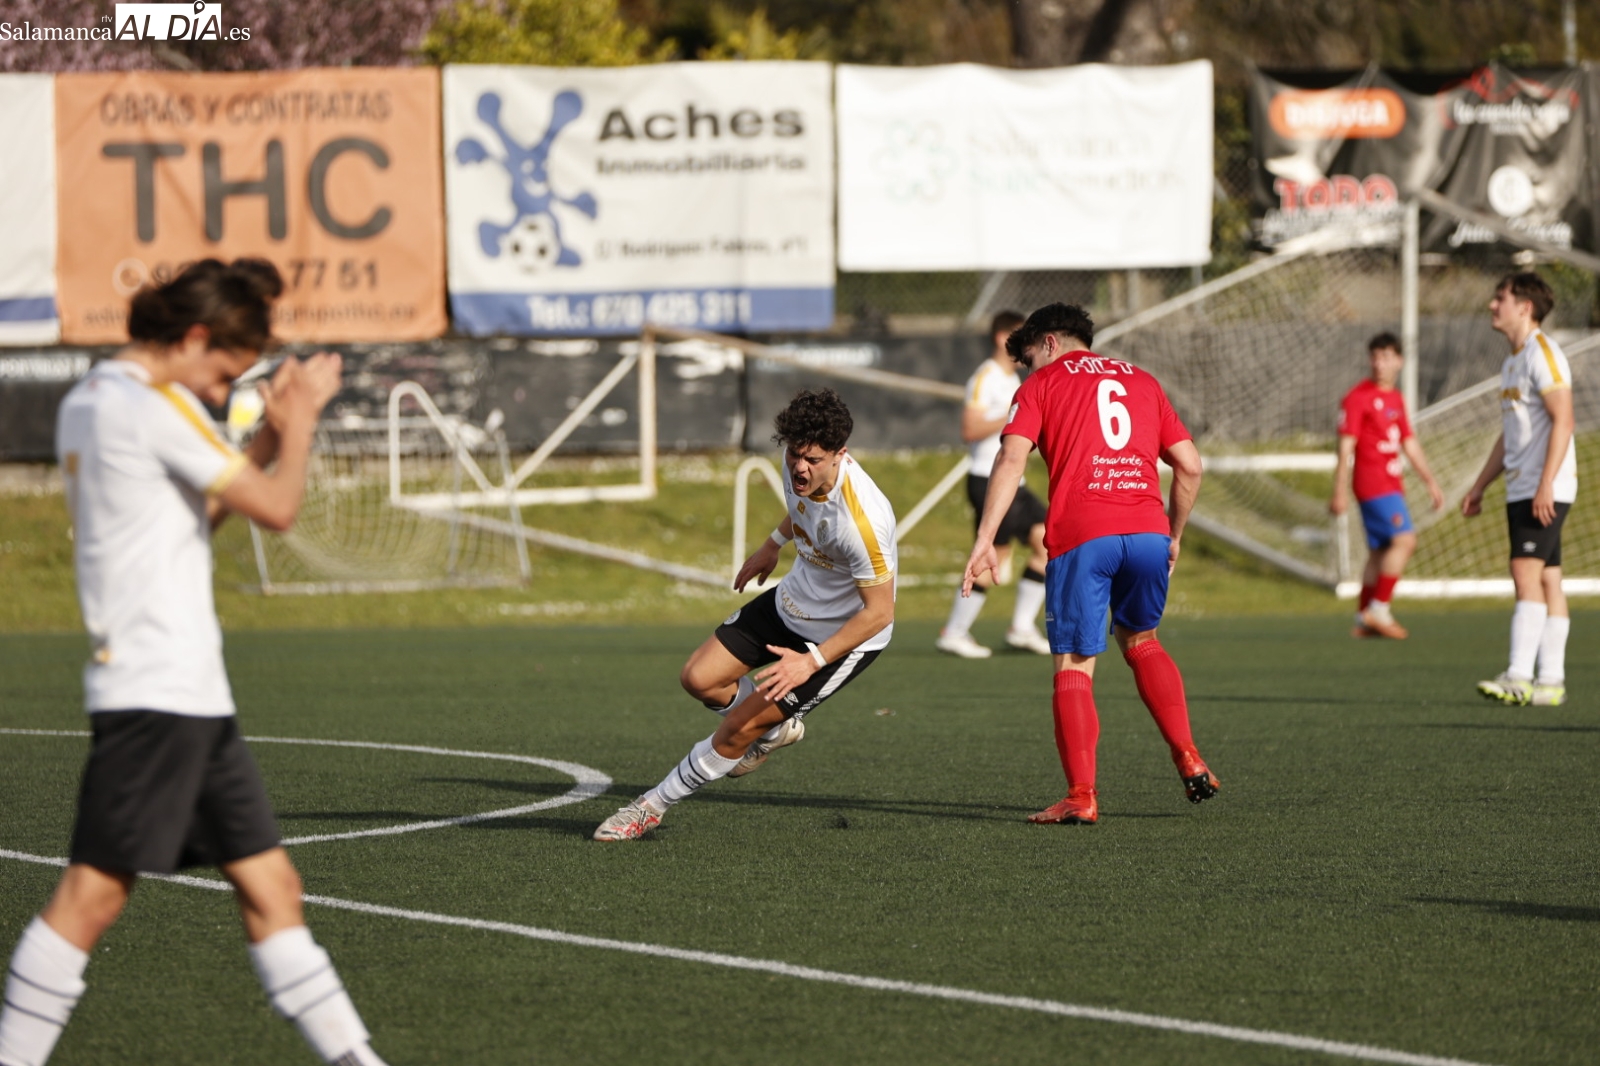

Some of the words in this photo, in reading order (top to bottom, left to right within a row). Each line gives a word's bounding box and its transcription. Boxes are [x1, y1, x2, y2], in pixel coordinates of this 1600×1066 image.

[101, 93, 196, 126] OBRAS
[201, 96, 221, 124] Y
[225, 90, 392, 124] CONTRATAS
[599, 103, 804, 141] Aches
[101, 136, 393, 244] THC
[289, 260, 327, 288] 77
[338, 259, 378, 289] 51
[1097, 378, 1132, 451] 6
[1092, 454, 1143, 467] Benavente,
[1088, 482, 1100, 490] en
[1103, 480, 1113, 492] el
